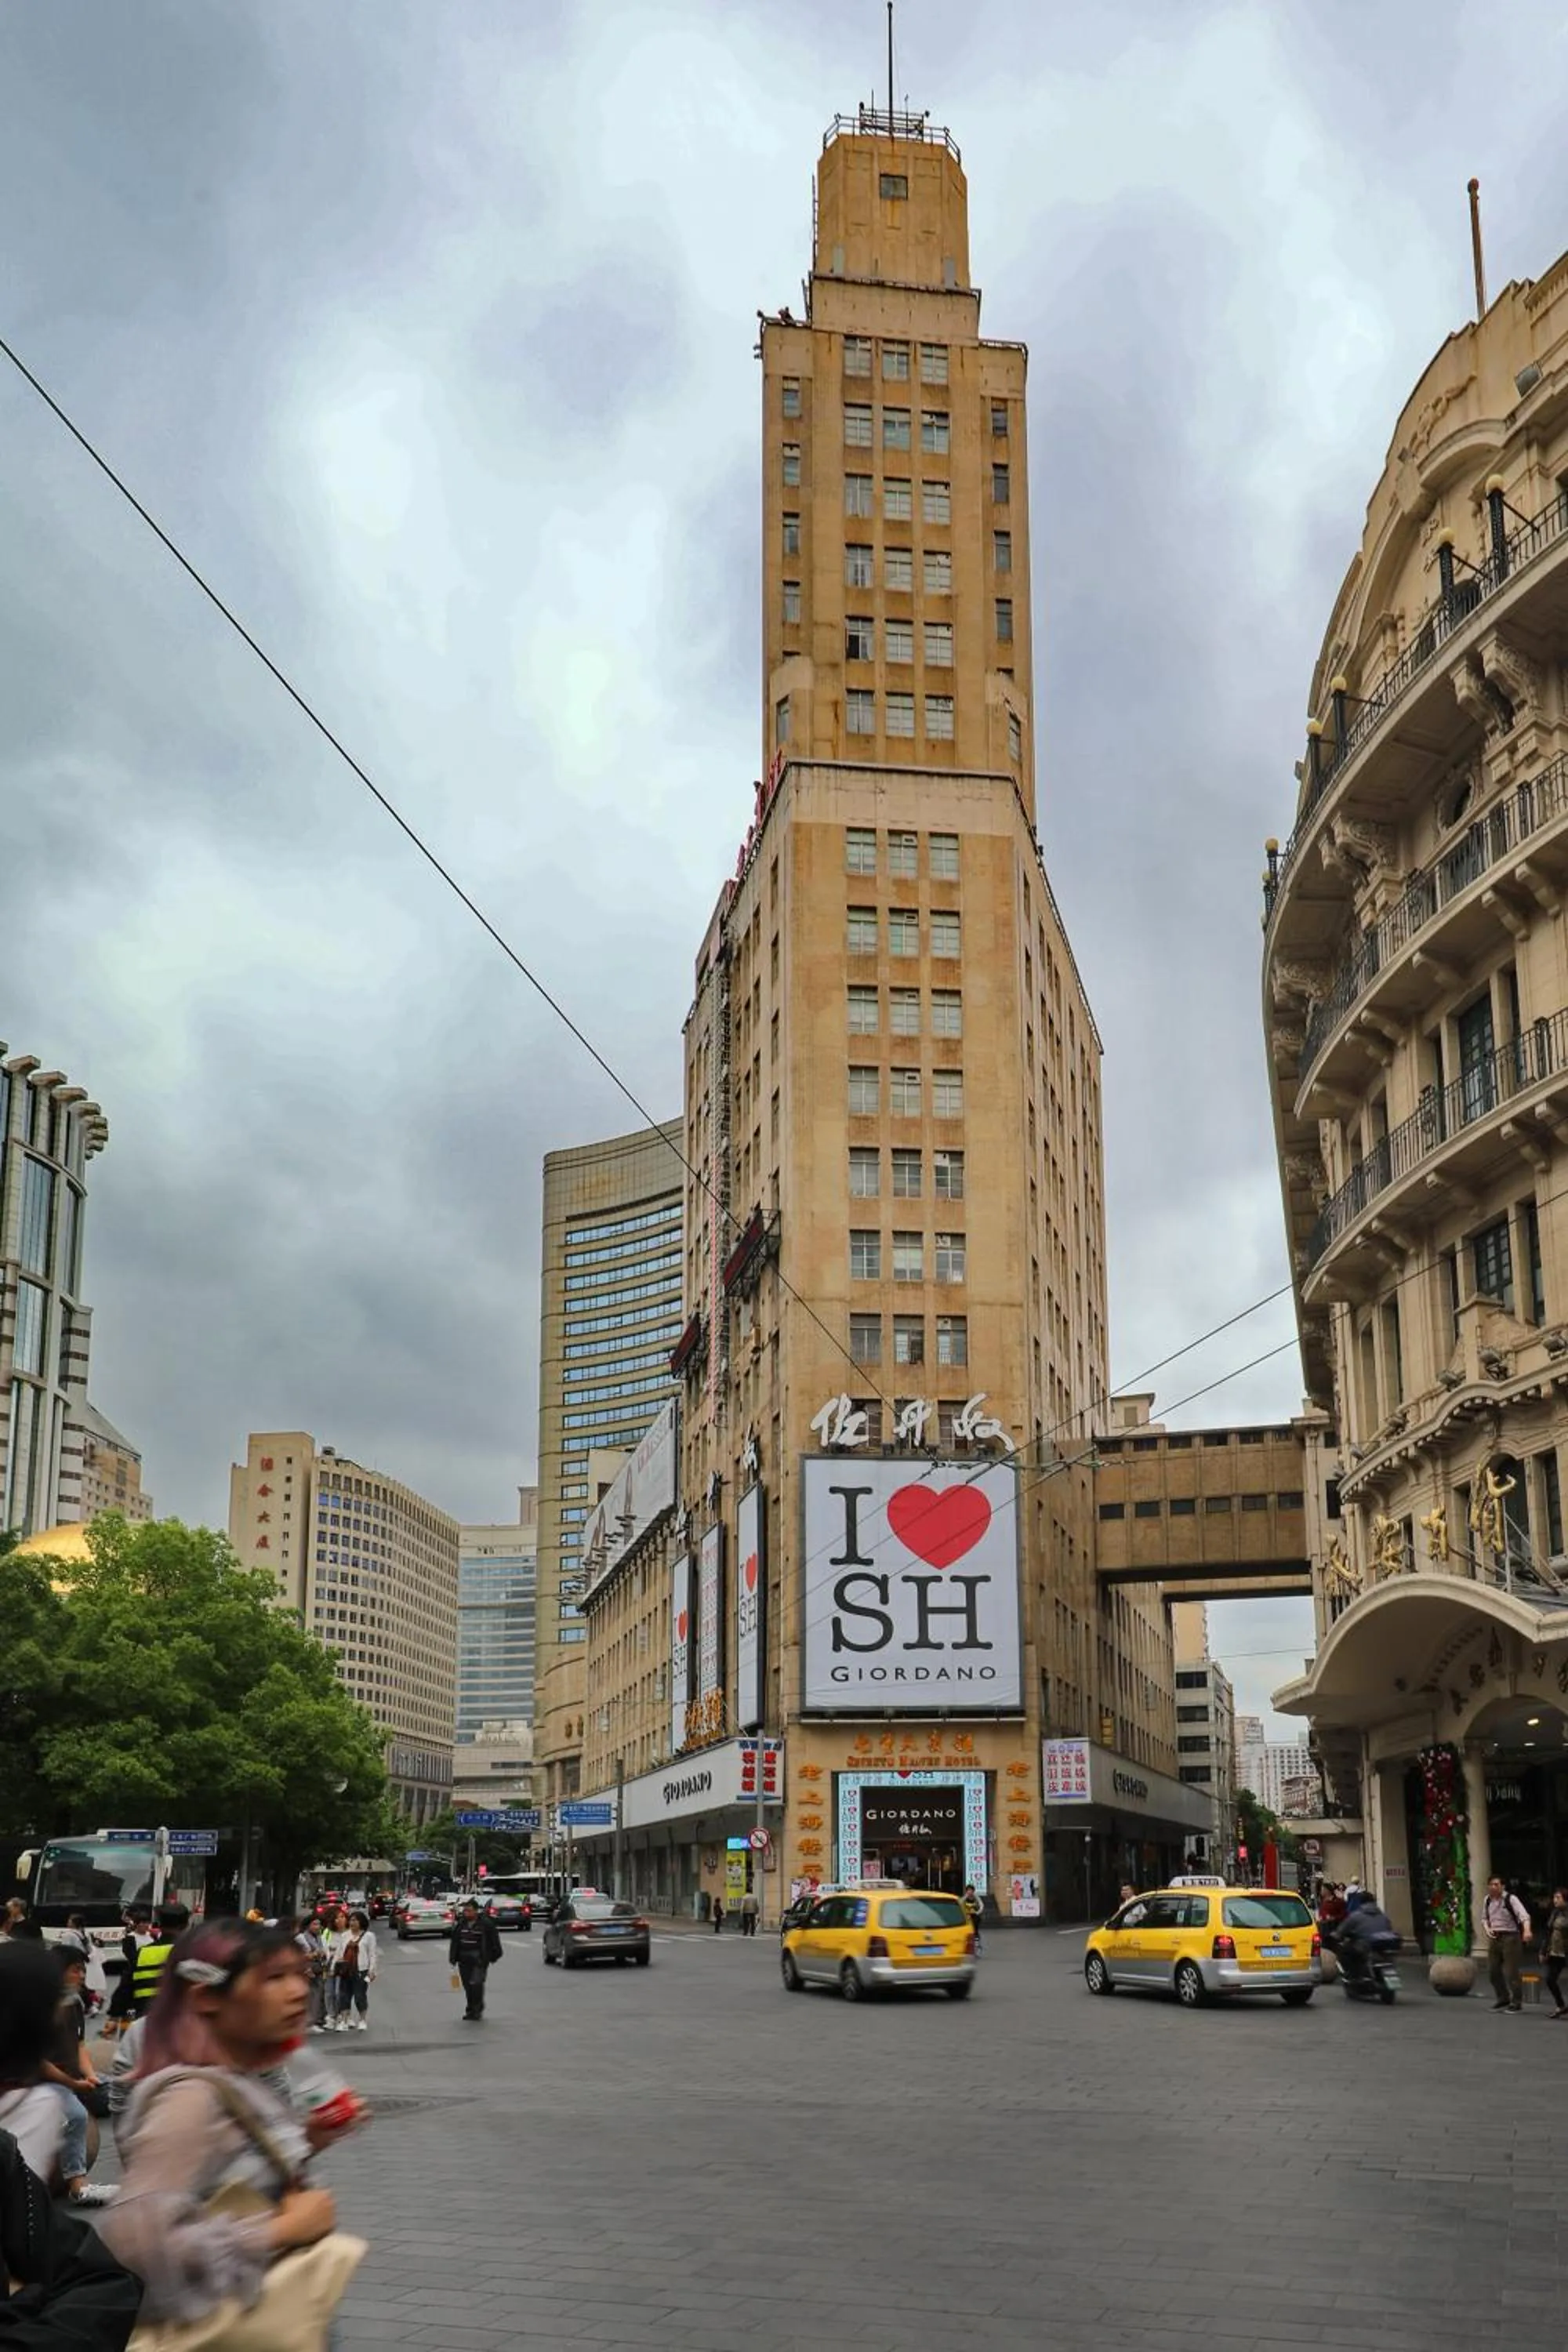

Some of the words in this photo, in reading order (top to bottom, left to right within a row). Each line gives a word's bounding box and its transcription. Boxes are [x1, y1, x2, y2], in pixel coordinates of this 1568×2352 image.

[829, 1486, 874, 1566] I
[832, 1572, 993, 1653] SH
[830, 1665, 996, 1682] GIORDANO
[866, 1809, 956, 1819] GIORDANO
